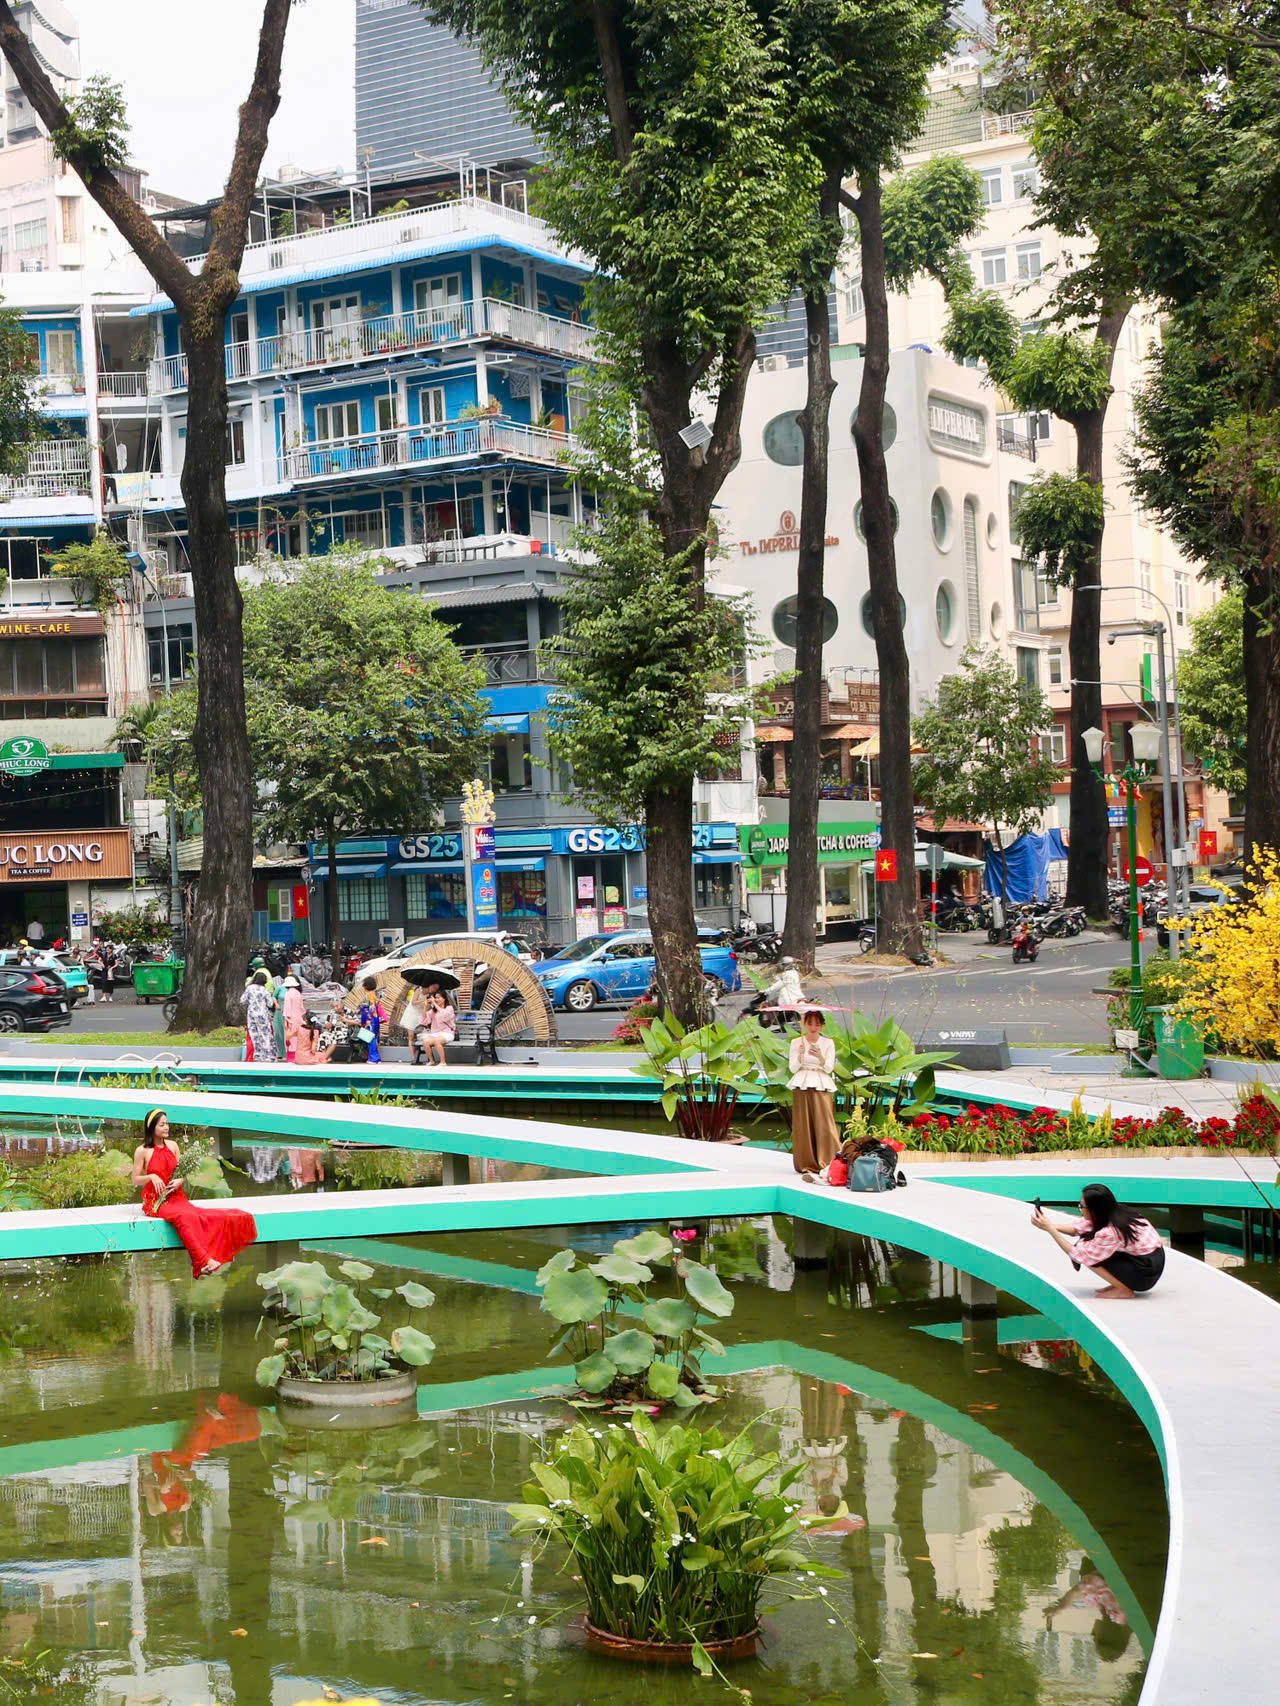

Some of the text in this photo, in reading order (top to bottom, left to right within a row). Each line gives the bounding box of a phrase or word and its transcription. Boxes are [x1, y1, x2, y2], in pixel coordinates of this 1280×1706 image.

[759, 536, 800, 554] IMPERI
[24, 759, 50, 768] LONG
[399, 835, 459, 859] GS25
[568, 828, 637, 853] GS25
[838, 835, 844, 850] &
[34, 842, 104, 863] LONG
[950, 1030, 977, 1038] VNPAY
